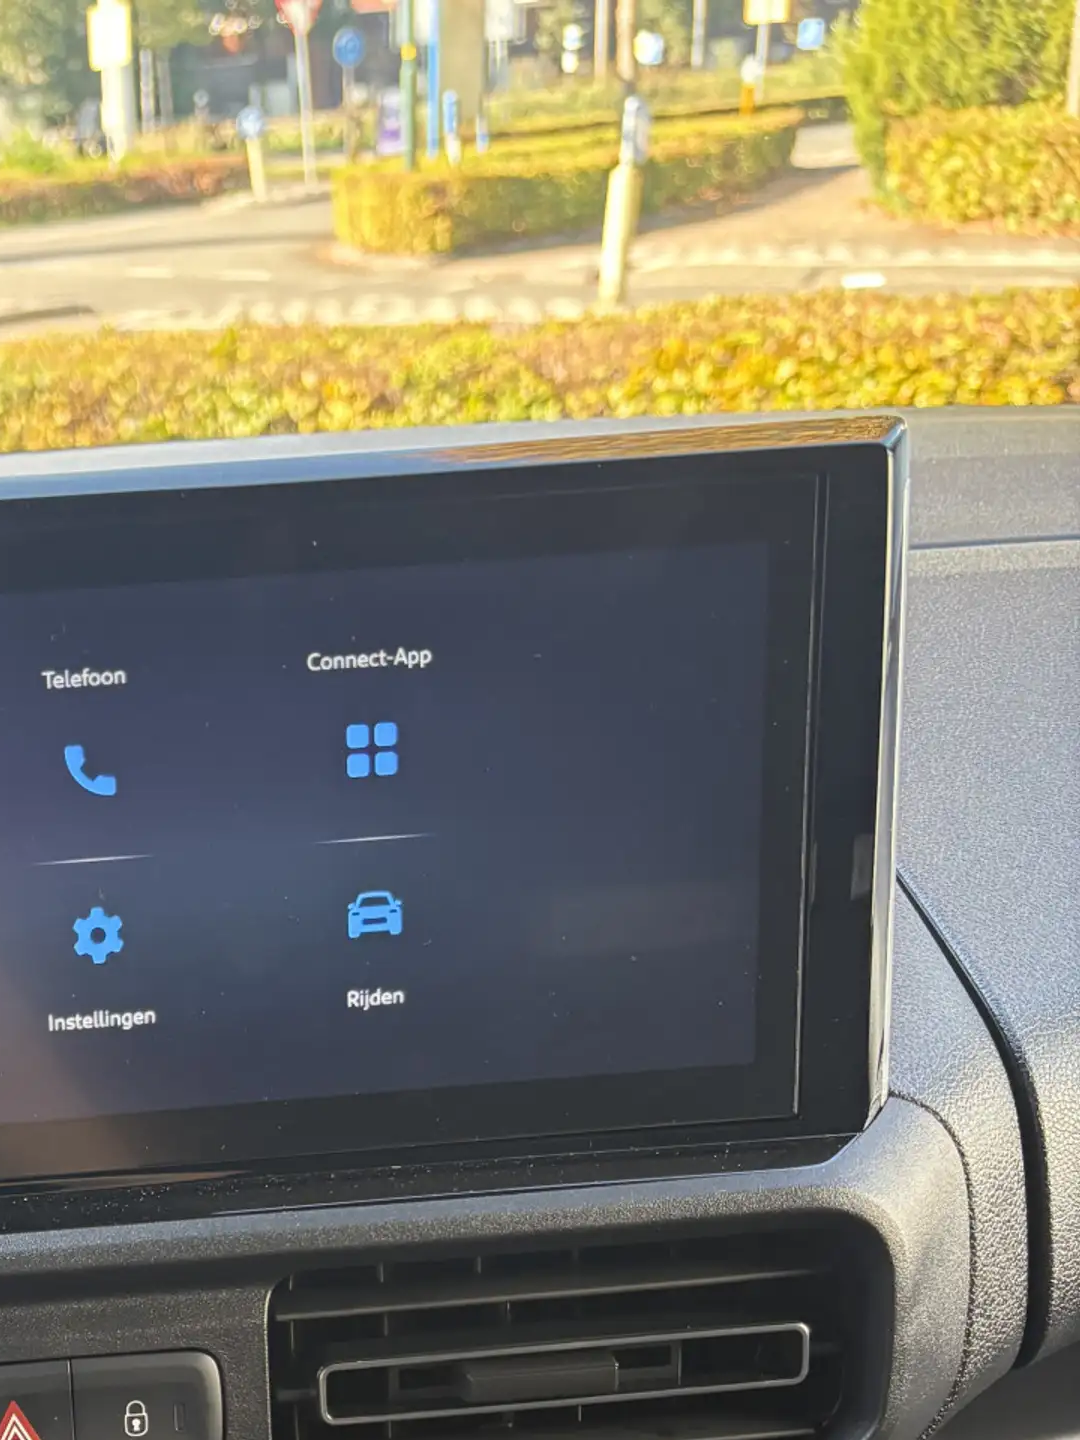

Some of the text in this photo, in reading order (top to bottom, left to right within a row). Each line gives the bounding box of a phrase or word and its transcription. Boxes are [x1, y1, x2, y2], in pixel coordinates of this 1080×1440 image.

[306, 646, 433, 672] Connect-App
[40, 666, 127, 690] Telefoon
[346, 986, 406, 1011] Rijden
[47, 1005, 157, 1033] Instellingen
